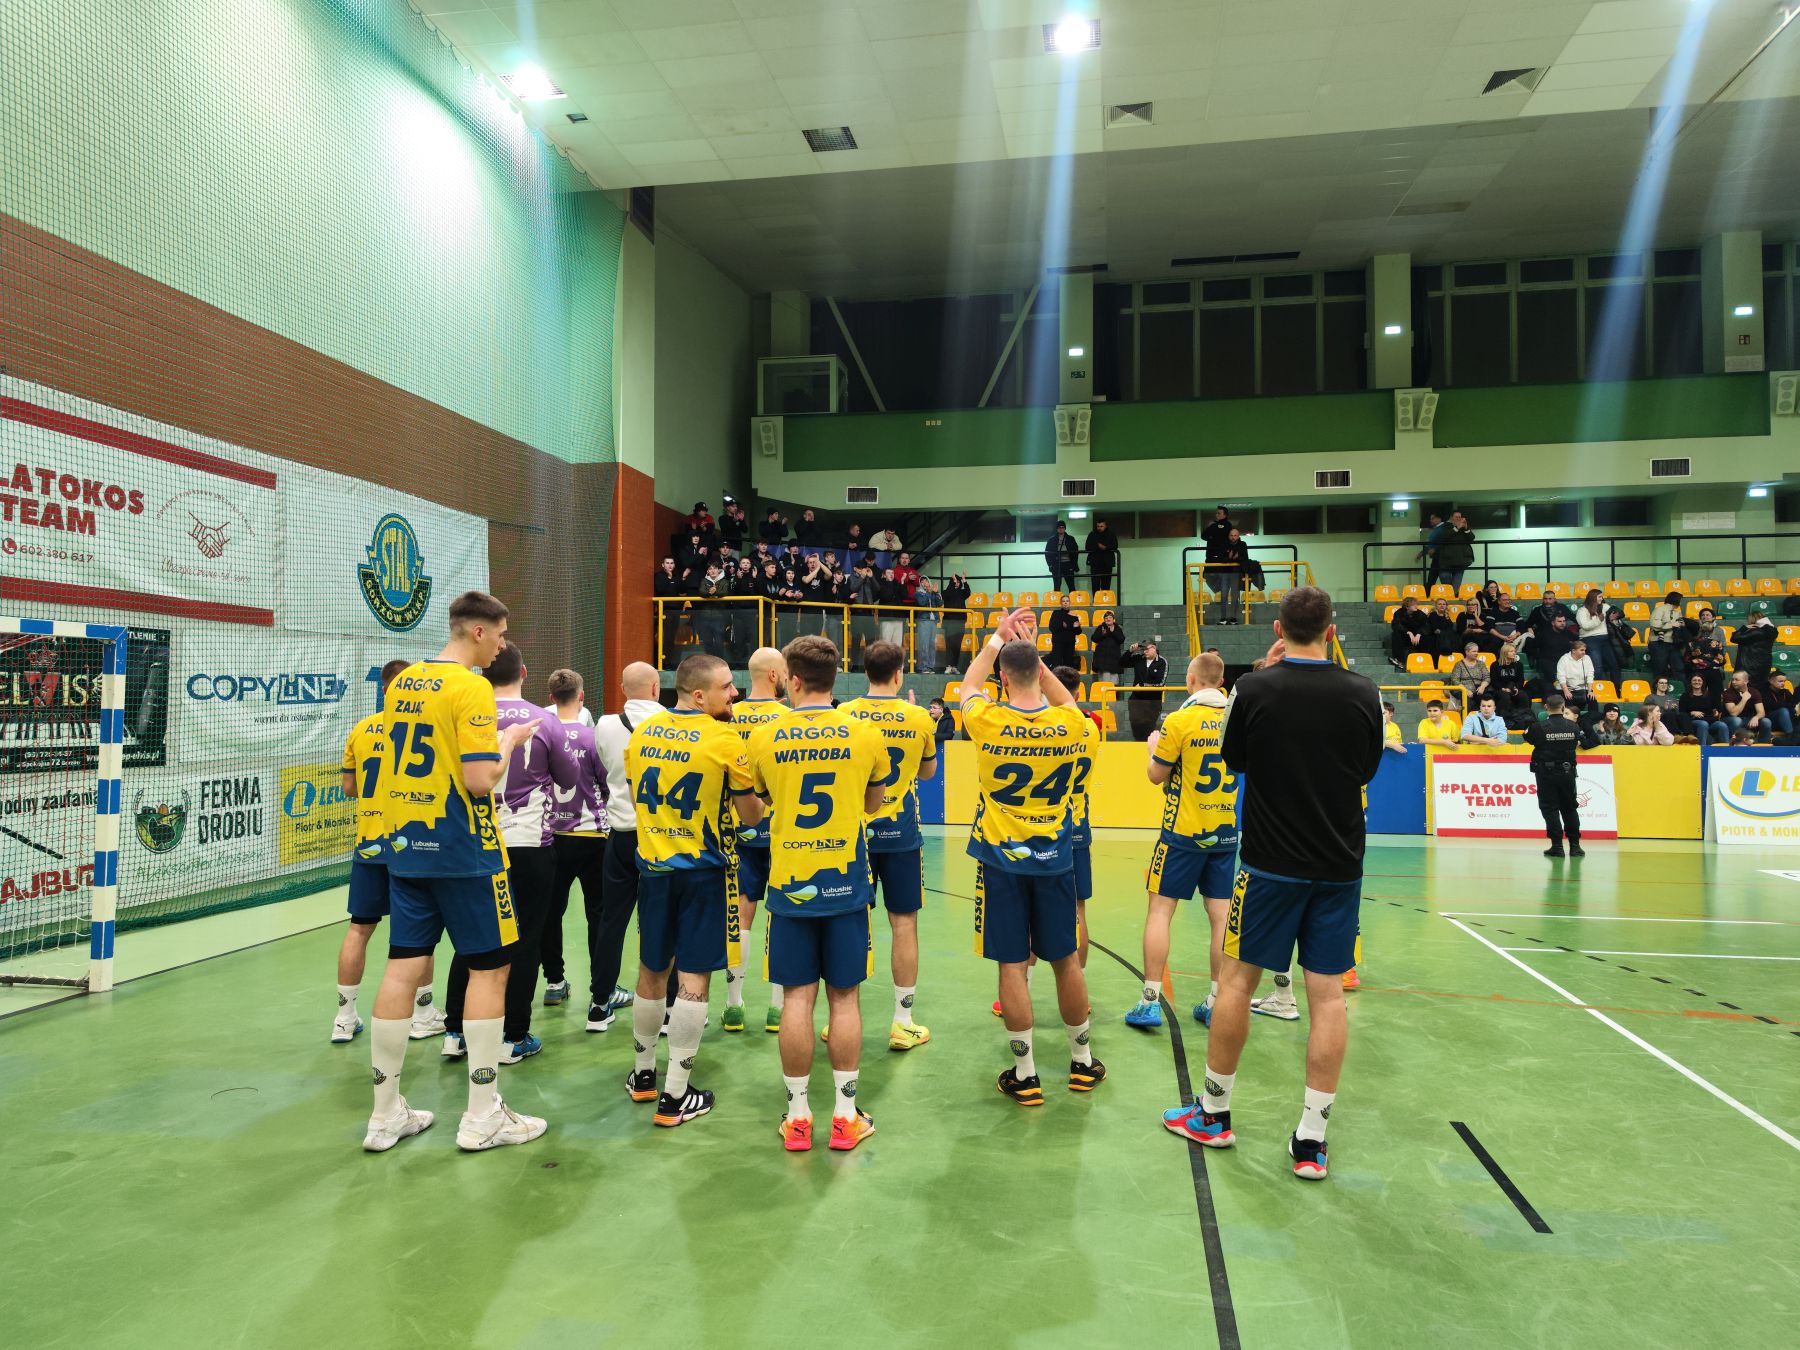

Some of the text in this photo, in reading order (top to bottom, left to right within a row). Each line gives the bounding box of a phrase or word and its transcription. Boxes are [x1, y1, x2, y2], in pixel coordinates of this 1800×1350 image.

[0, 494, 97, 536] TEAM
[395, 676, 443, 692] ARGOS
[395, 699, 424, 716] ZAJĄ
[497, 708, 530, 719] GOS
[642, 725, 701, 743] ARGOS
[774, 725, 850, 743] ARGOS
[1000, 724, 1068, 739] ARGOS
[389, 721, 435, 778] 15
[1190, 738, 1219, 748] NOWA
[639, 745, 691, 763] KOLANO
[774, 747, 851, 764] WĄTROBA
[200, 776, 262, 810] FERMA
[636, 766, 704, 820] 44
[989, 761, 1074, 807] 24
[1440, 783, 1538, 795] #PLATOKOS
[0, 793, 39, 818] odny
[794, 772, 836, 829] 5
[1465, 796, 1512, 807] TEAM
[1163, 793, 1179, 832] KSSG
[198, 807, 264, 844] DROBIU
[1722, 825, 1755, 837] PIOTR
[1153, 847, 1165, 876] KSSG
[496, 879, 513, 920] KSSG
[821, 885, 853, 894] Lubuskie
[727, 868, 741, 943] KSSG 194
[1228, 892, 1242, 936] KSSG
